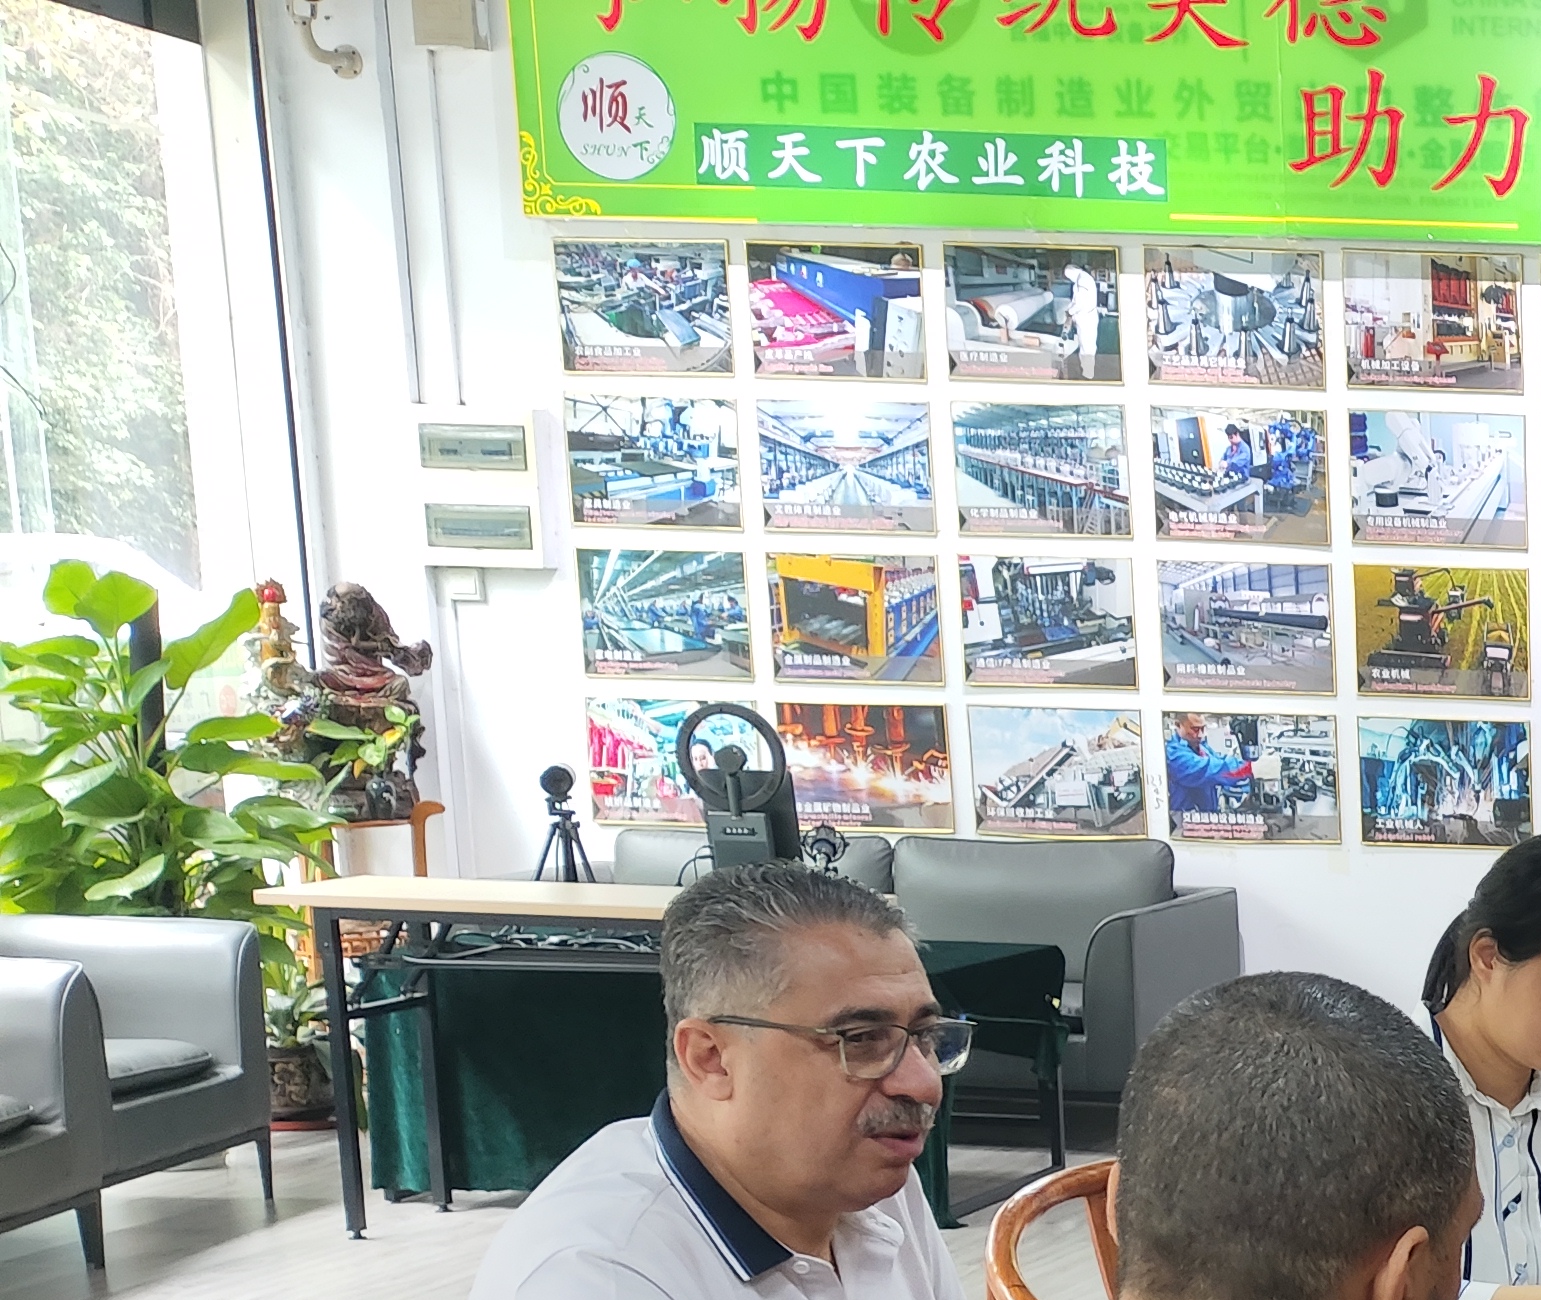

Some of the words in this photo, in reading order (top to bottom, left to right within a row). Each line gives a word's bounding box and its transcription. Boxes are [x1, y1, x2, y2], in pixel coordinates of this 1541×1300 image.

[699, 128, 1167, 198] 顺天下农业科技
